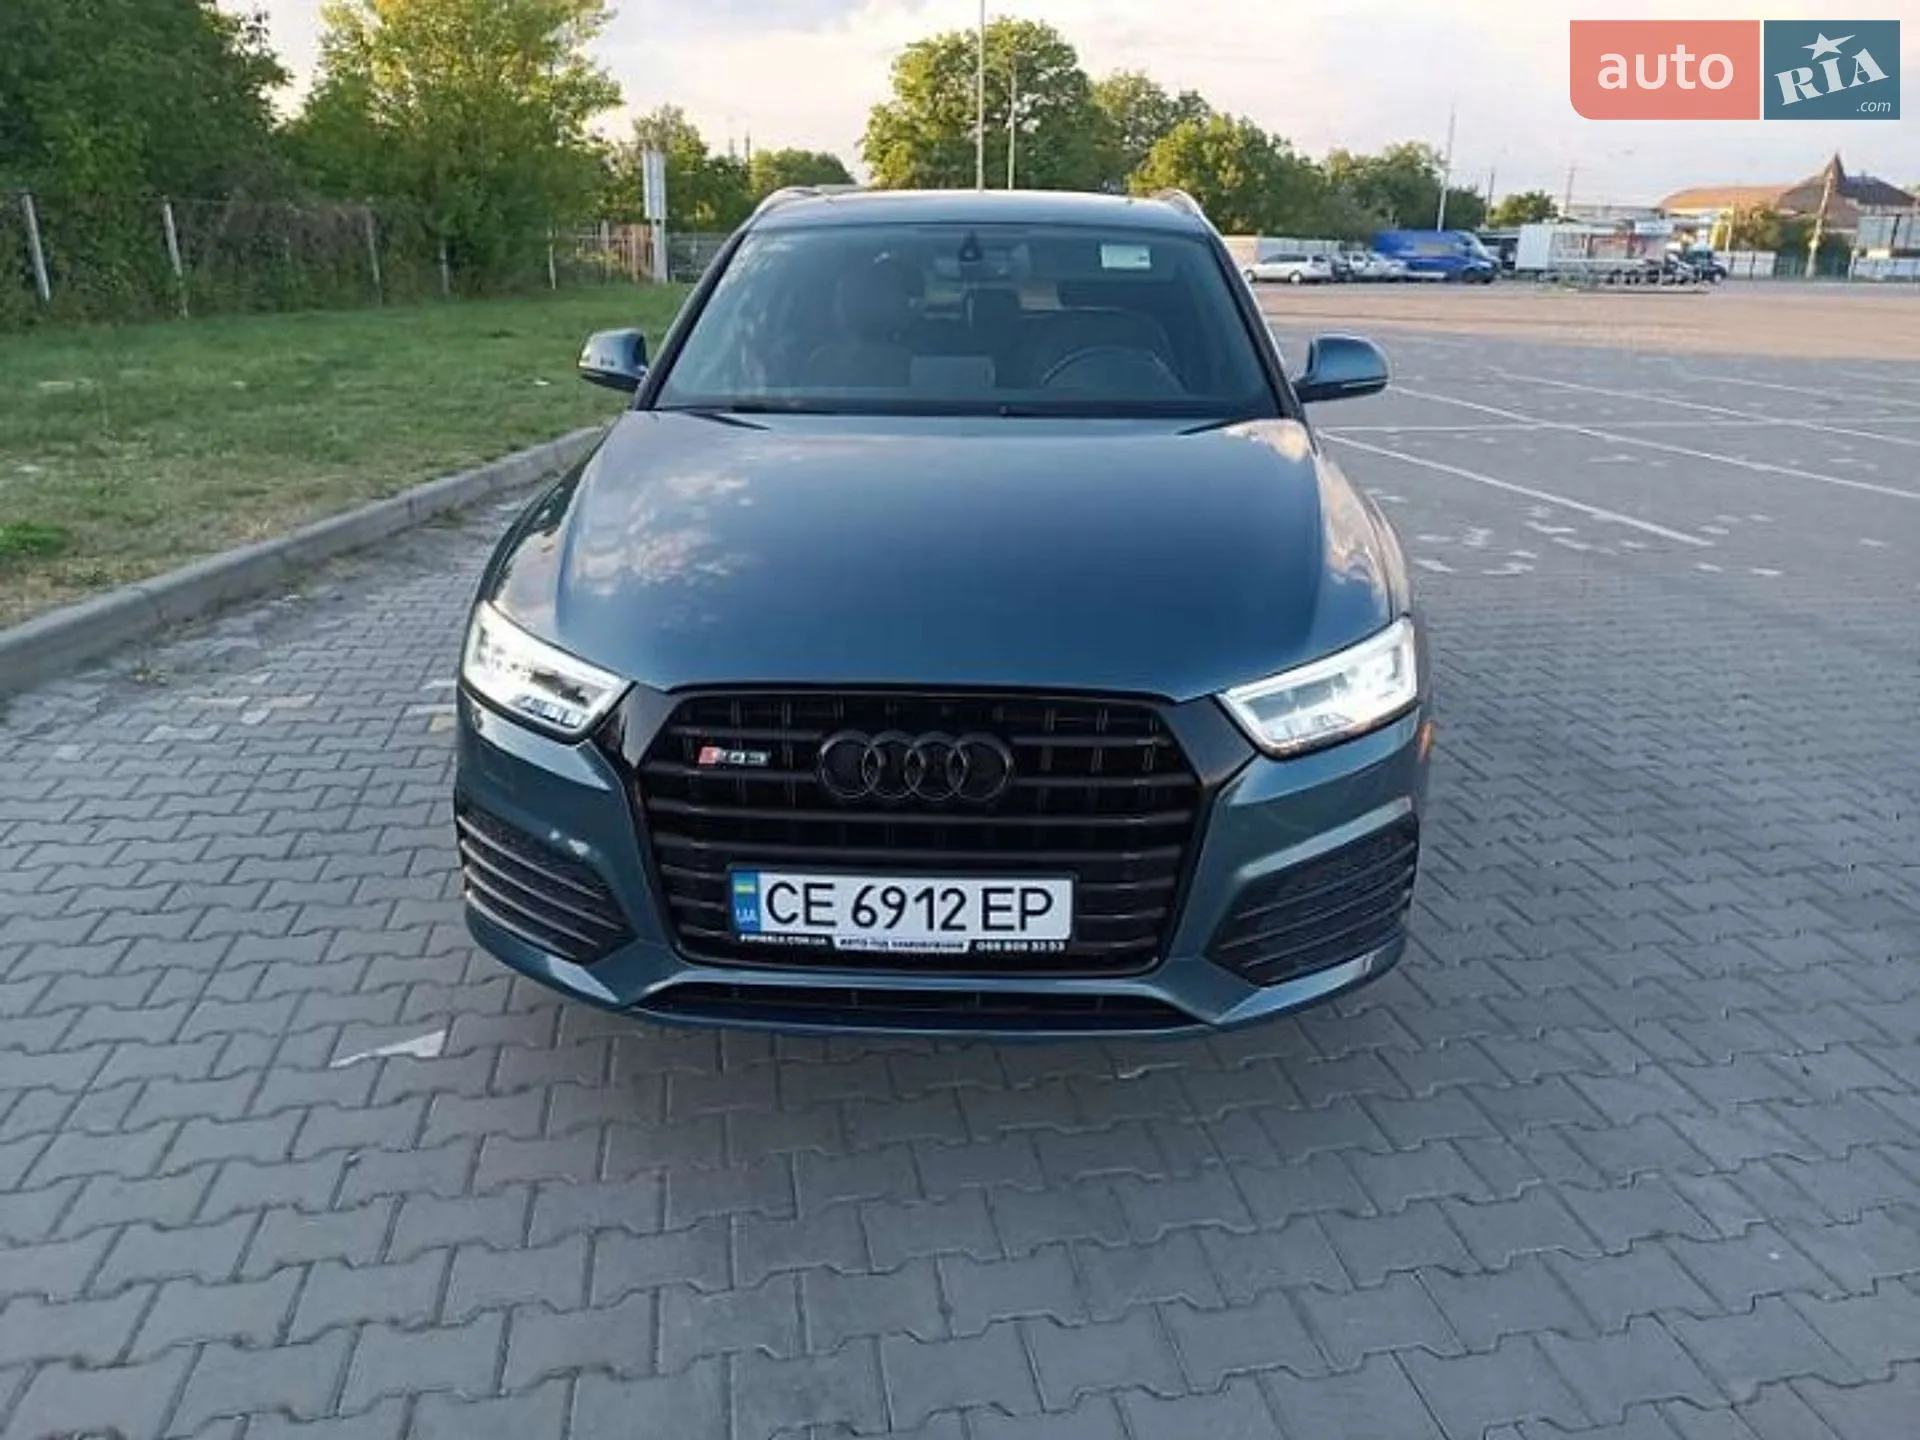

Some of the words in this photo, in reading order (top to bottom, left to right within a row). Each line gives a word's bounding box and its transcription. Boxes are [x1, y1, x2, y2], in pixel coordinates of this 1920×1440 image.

[735, 908, 758, 922] UA
[766, 882, 837, 927] CE
[851, 885, 967, 931] 6912
[981, 887, 1053, 931] EP
